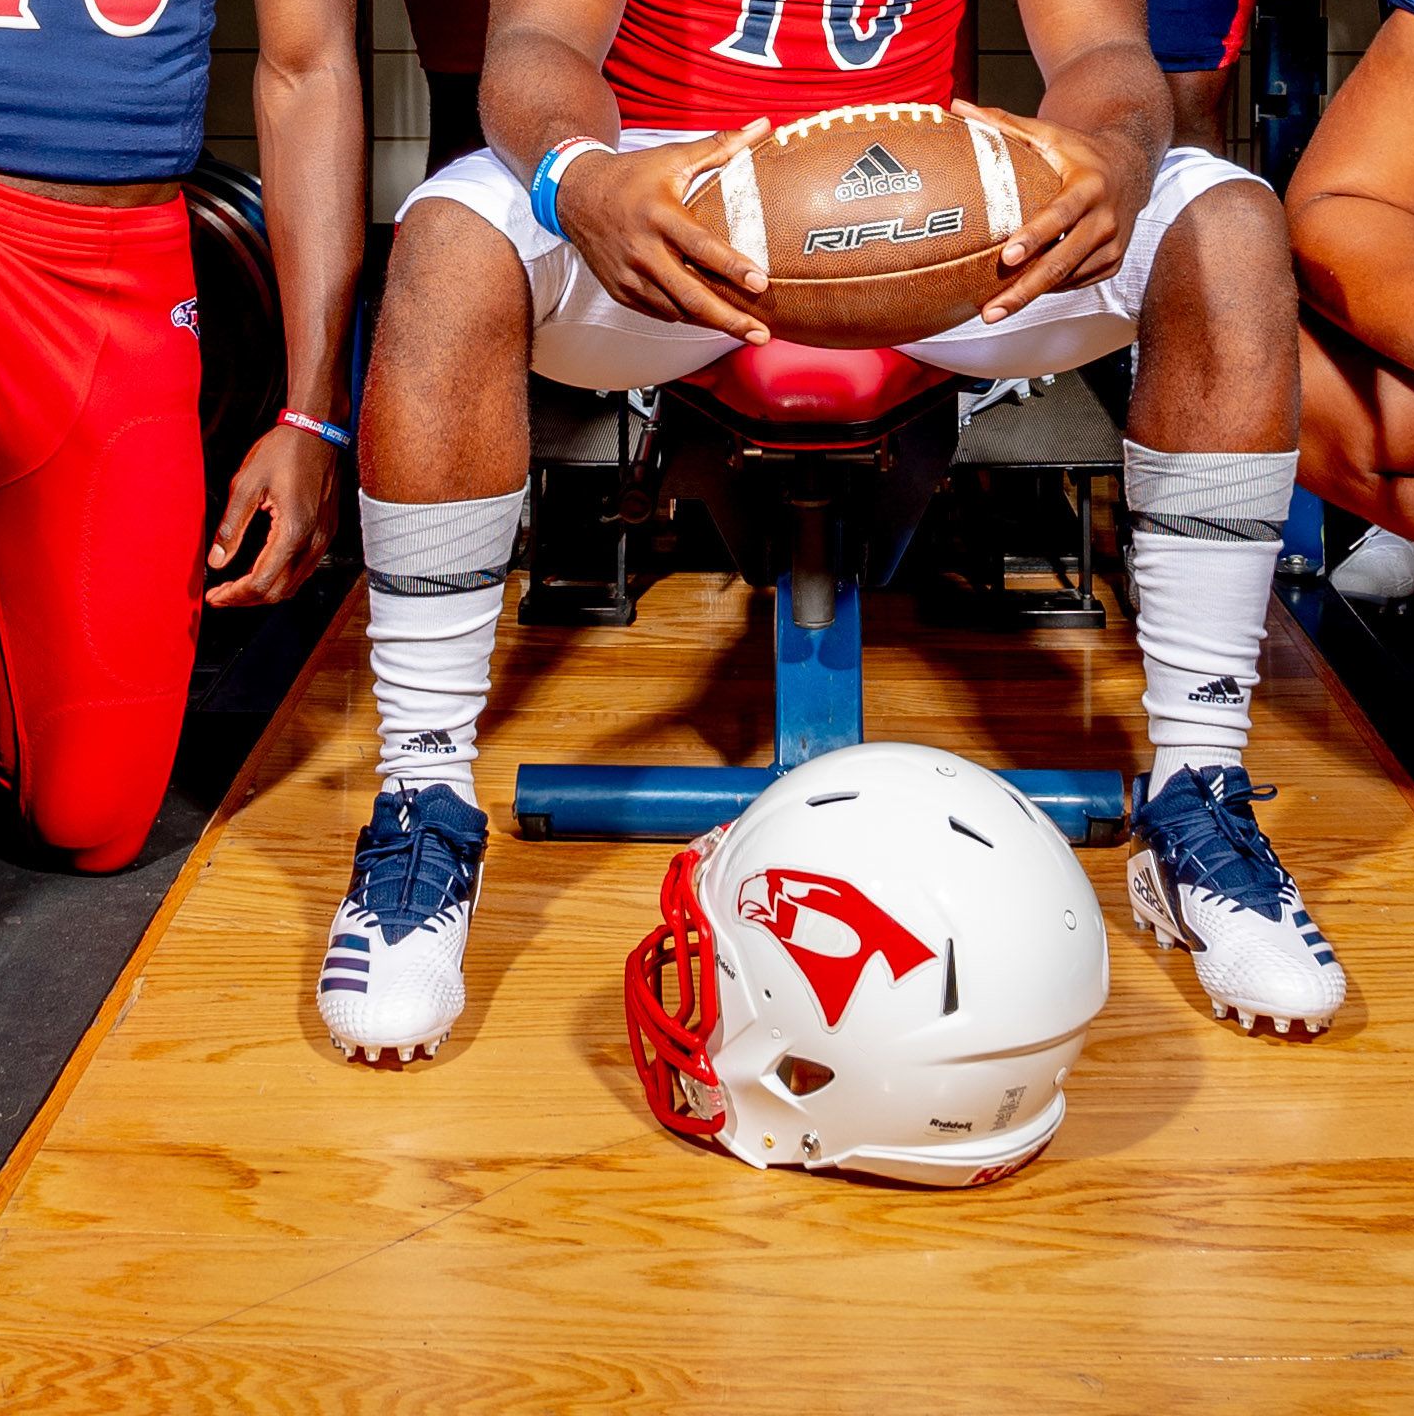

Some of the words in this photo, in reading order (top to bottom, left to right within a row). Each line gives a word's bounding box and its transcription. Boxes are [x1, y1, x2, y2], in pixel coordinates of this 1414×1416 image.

[835, 173, 923, 202] adidas
[803, 207, 964, 254] RIFLE
[1188, 687, 1245, 705] adidas
[929, 1117, 973, 1132] Riddell
